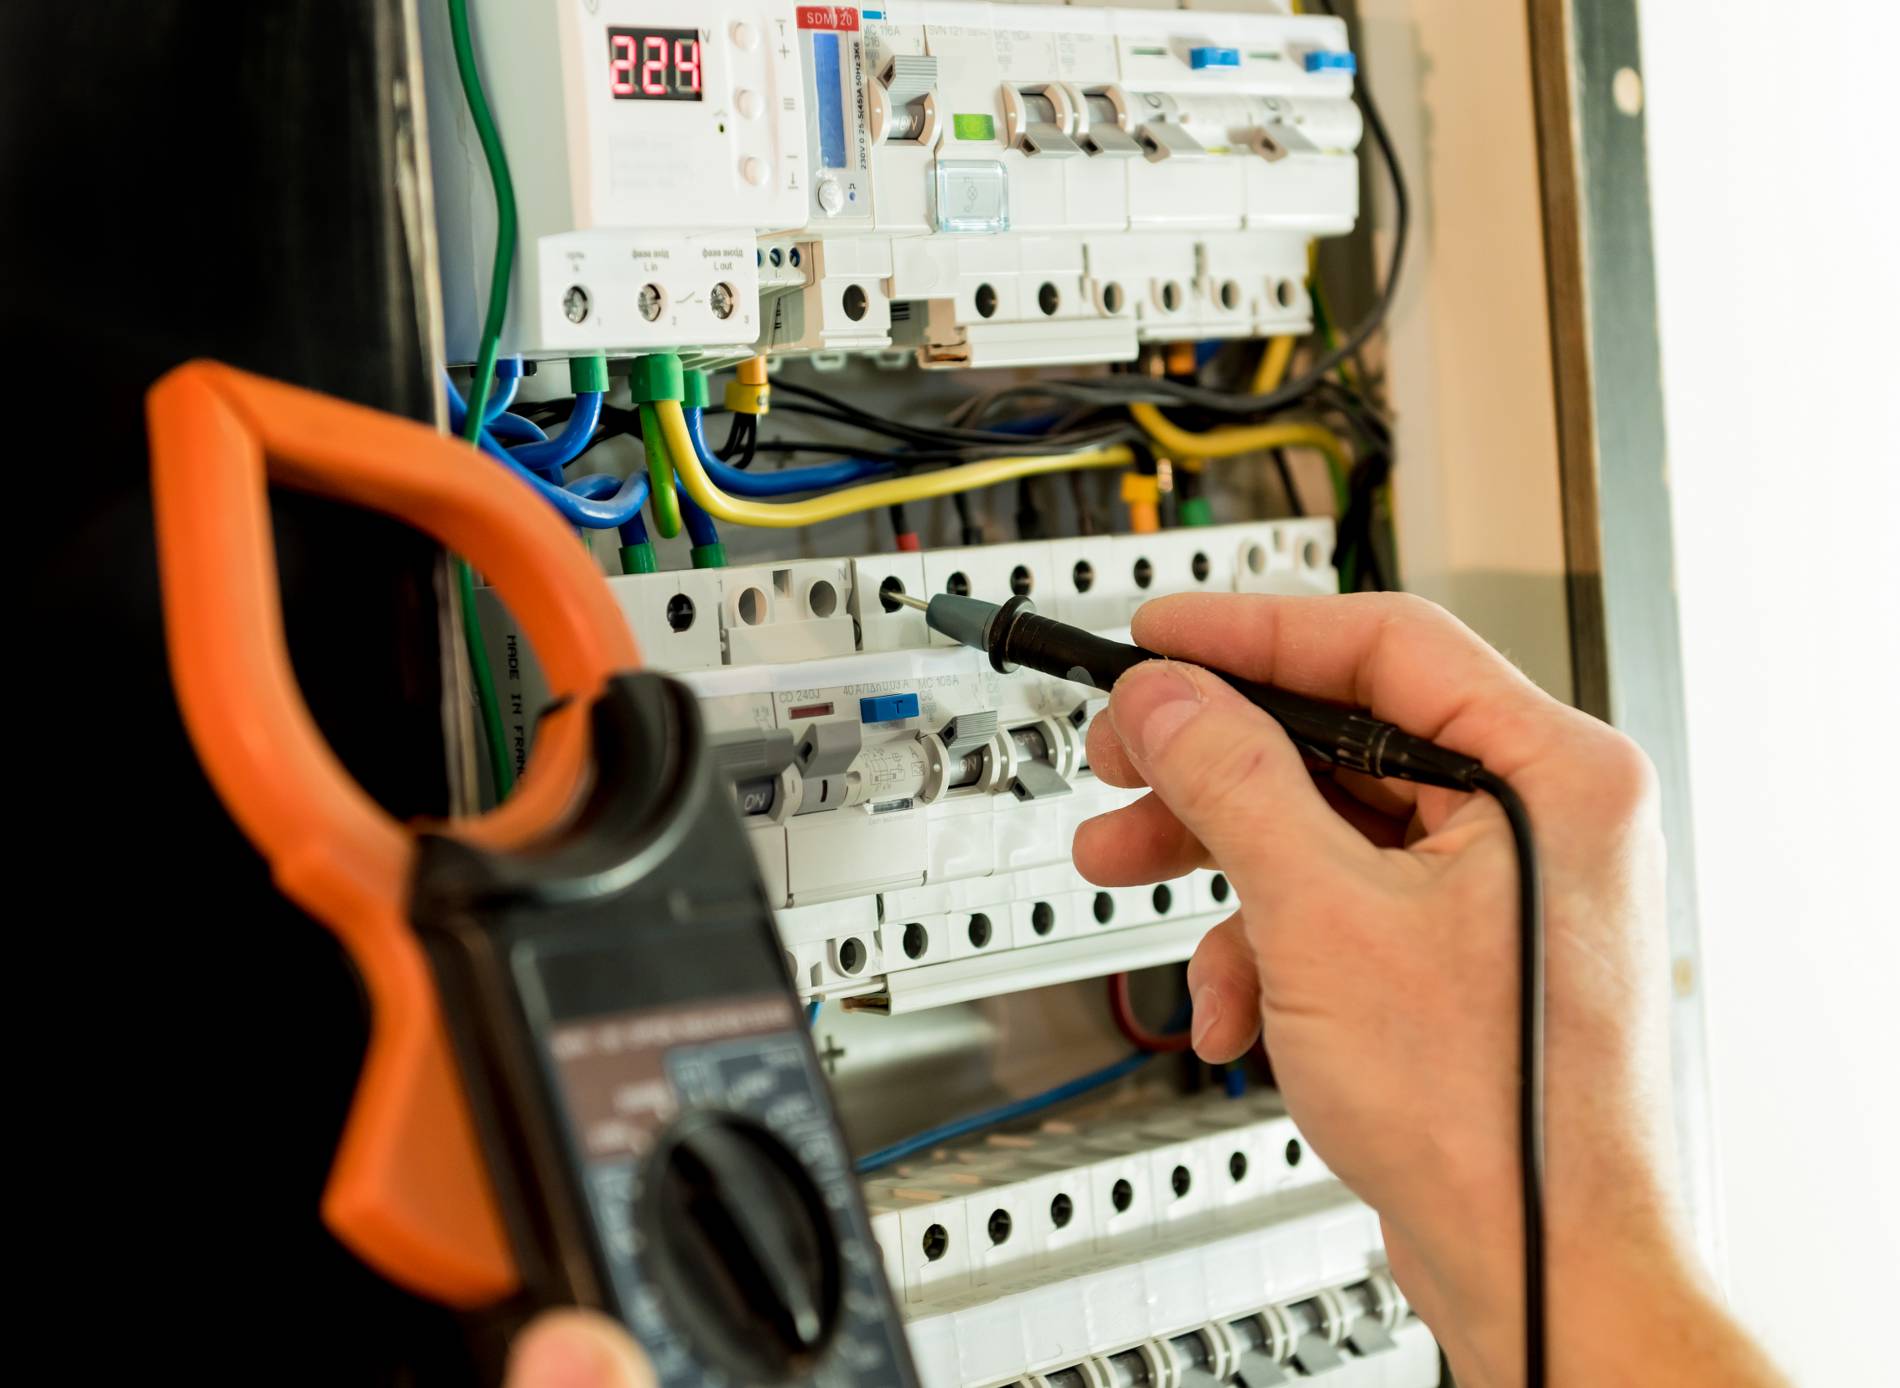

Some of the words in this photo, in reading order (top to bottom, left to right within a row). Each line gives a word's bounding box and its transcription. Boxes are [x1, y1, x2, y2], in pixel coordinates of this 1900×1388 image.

[609, 35, 700, 94] 224
[507, 635, 520, 680] MADE
[512, 694, 523, 715] IN
[958, 757, 978, 772] ON
[744, 792, 766, 811] ON
